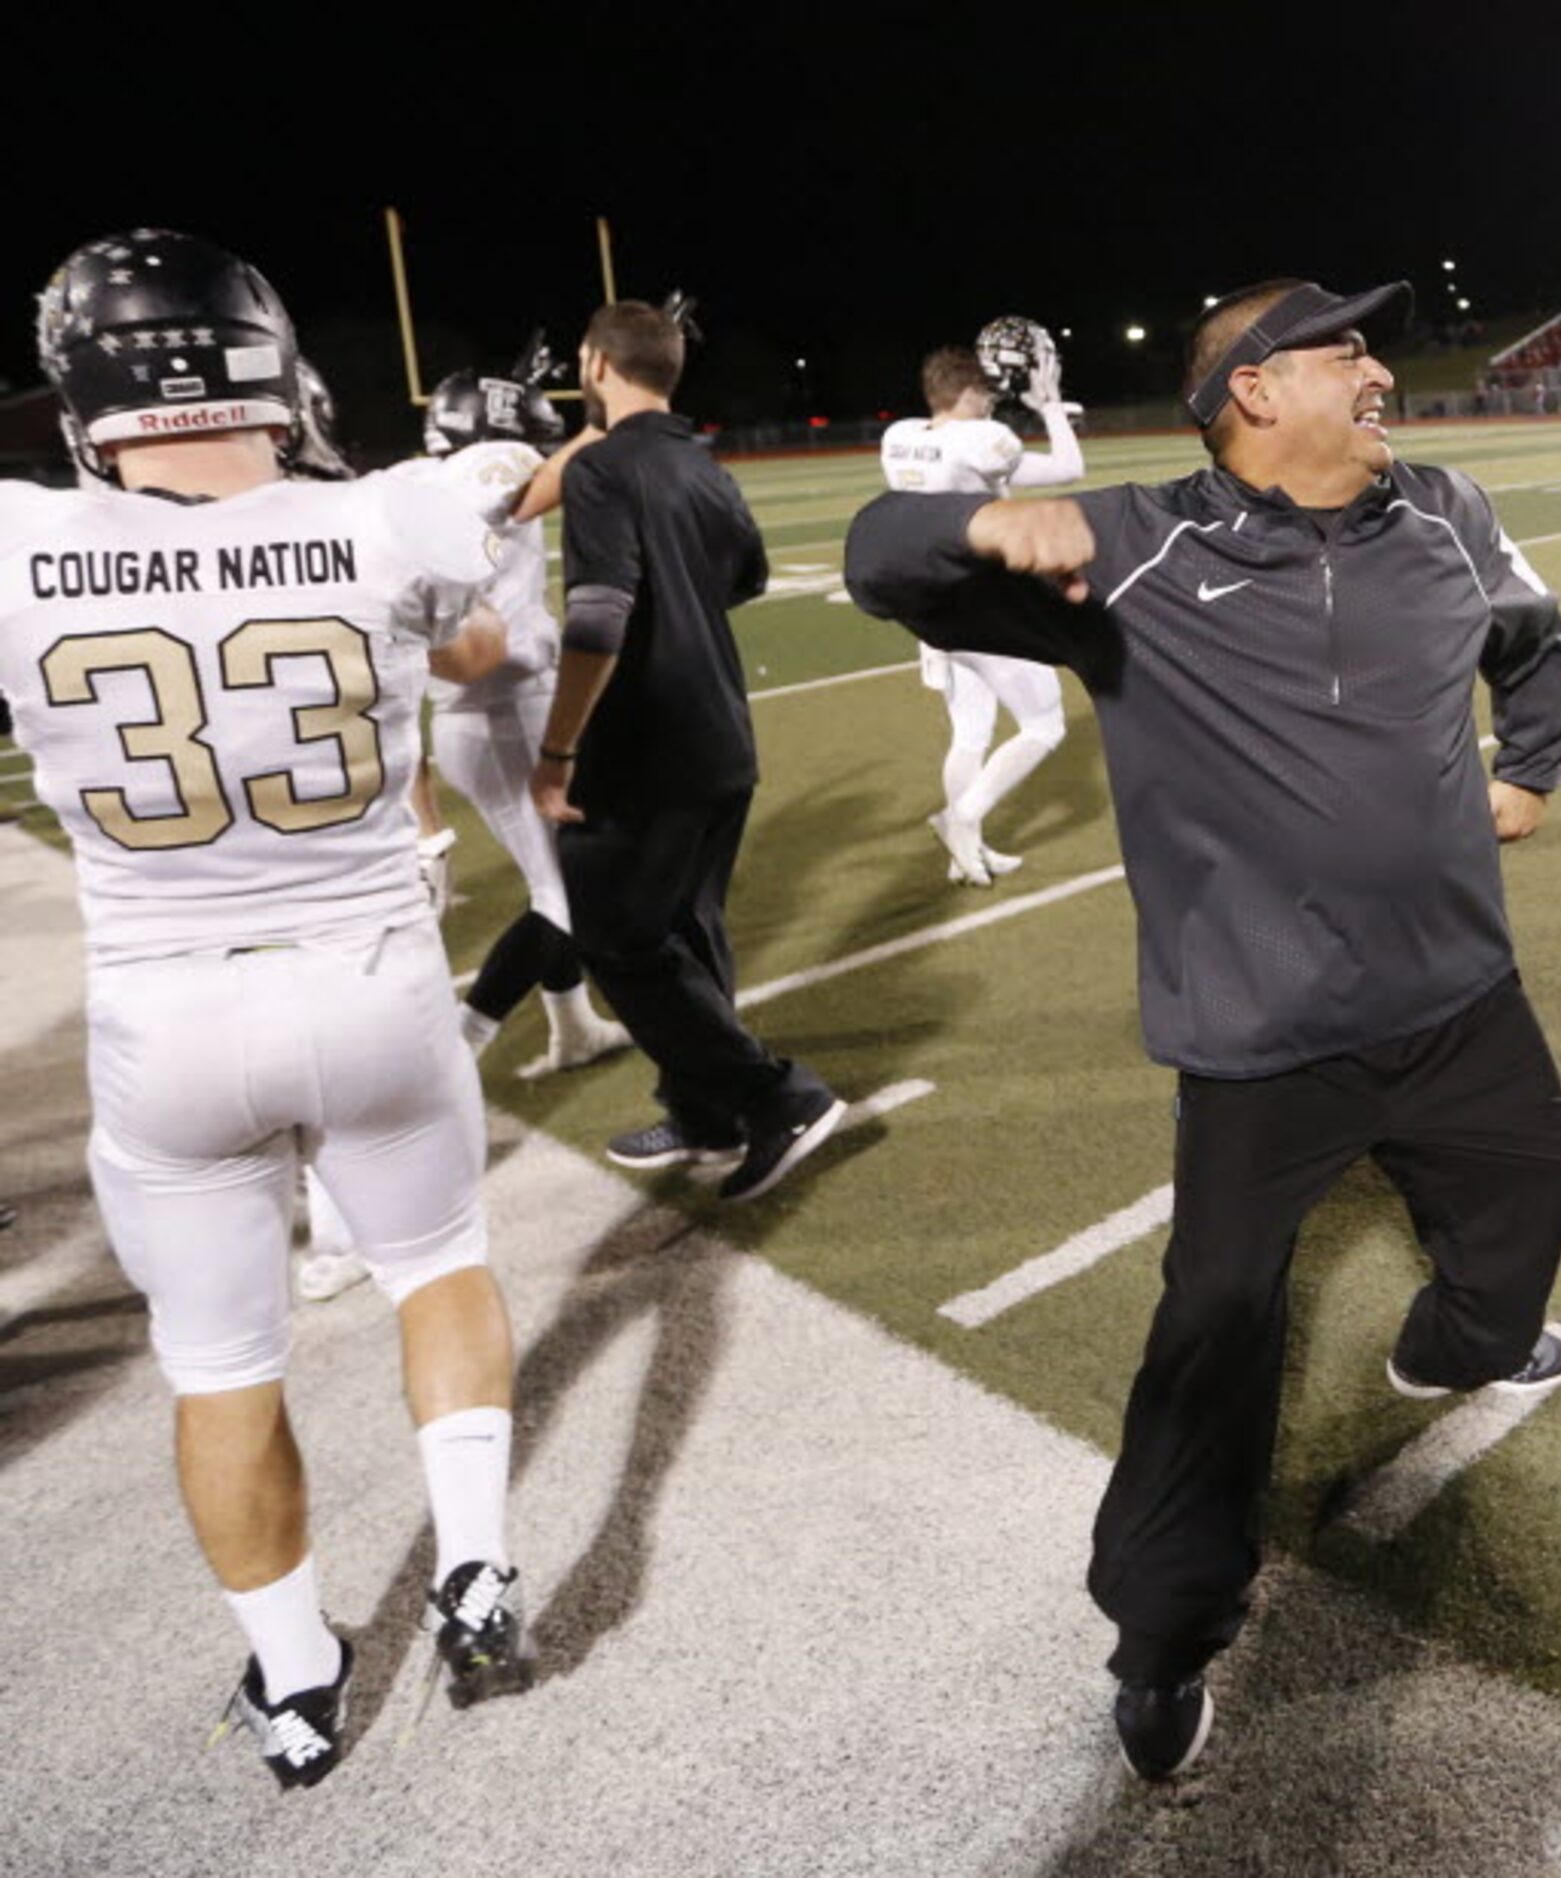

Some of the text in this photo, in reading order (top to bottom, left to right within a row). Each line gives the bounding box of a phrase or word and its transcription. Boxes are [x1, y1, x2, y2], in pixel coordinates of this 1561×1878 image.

[138, 405, 246, 431] Riddell
[31, 539, 357, 599] COUGAR NATION
[39, 615, 384, 850] 33
